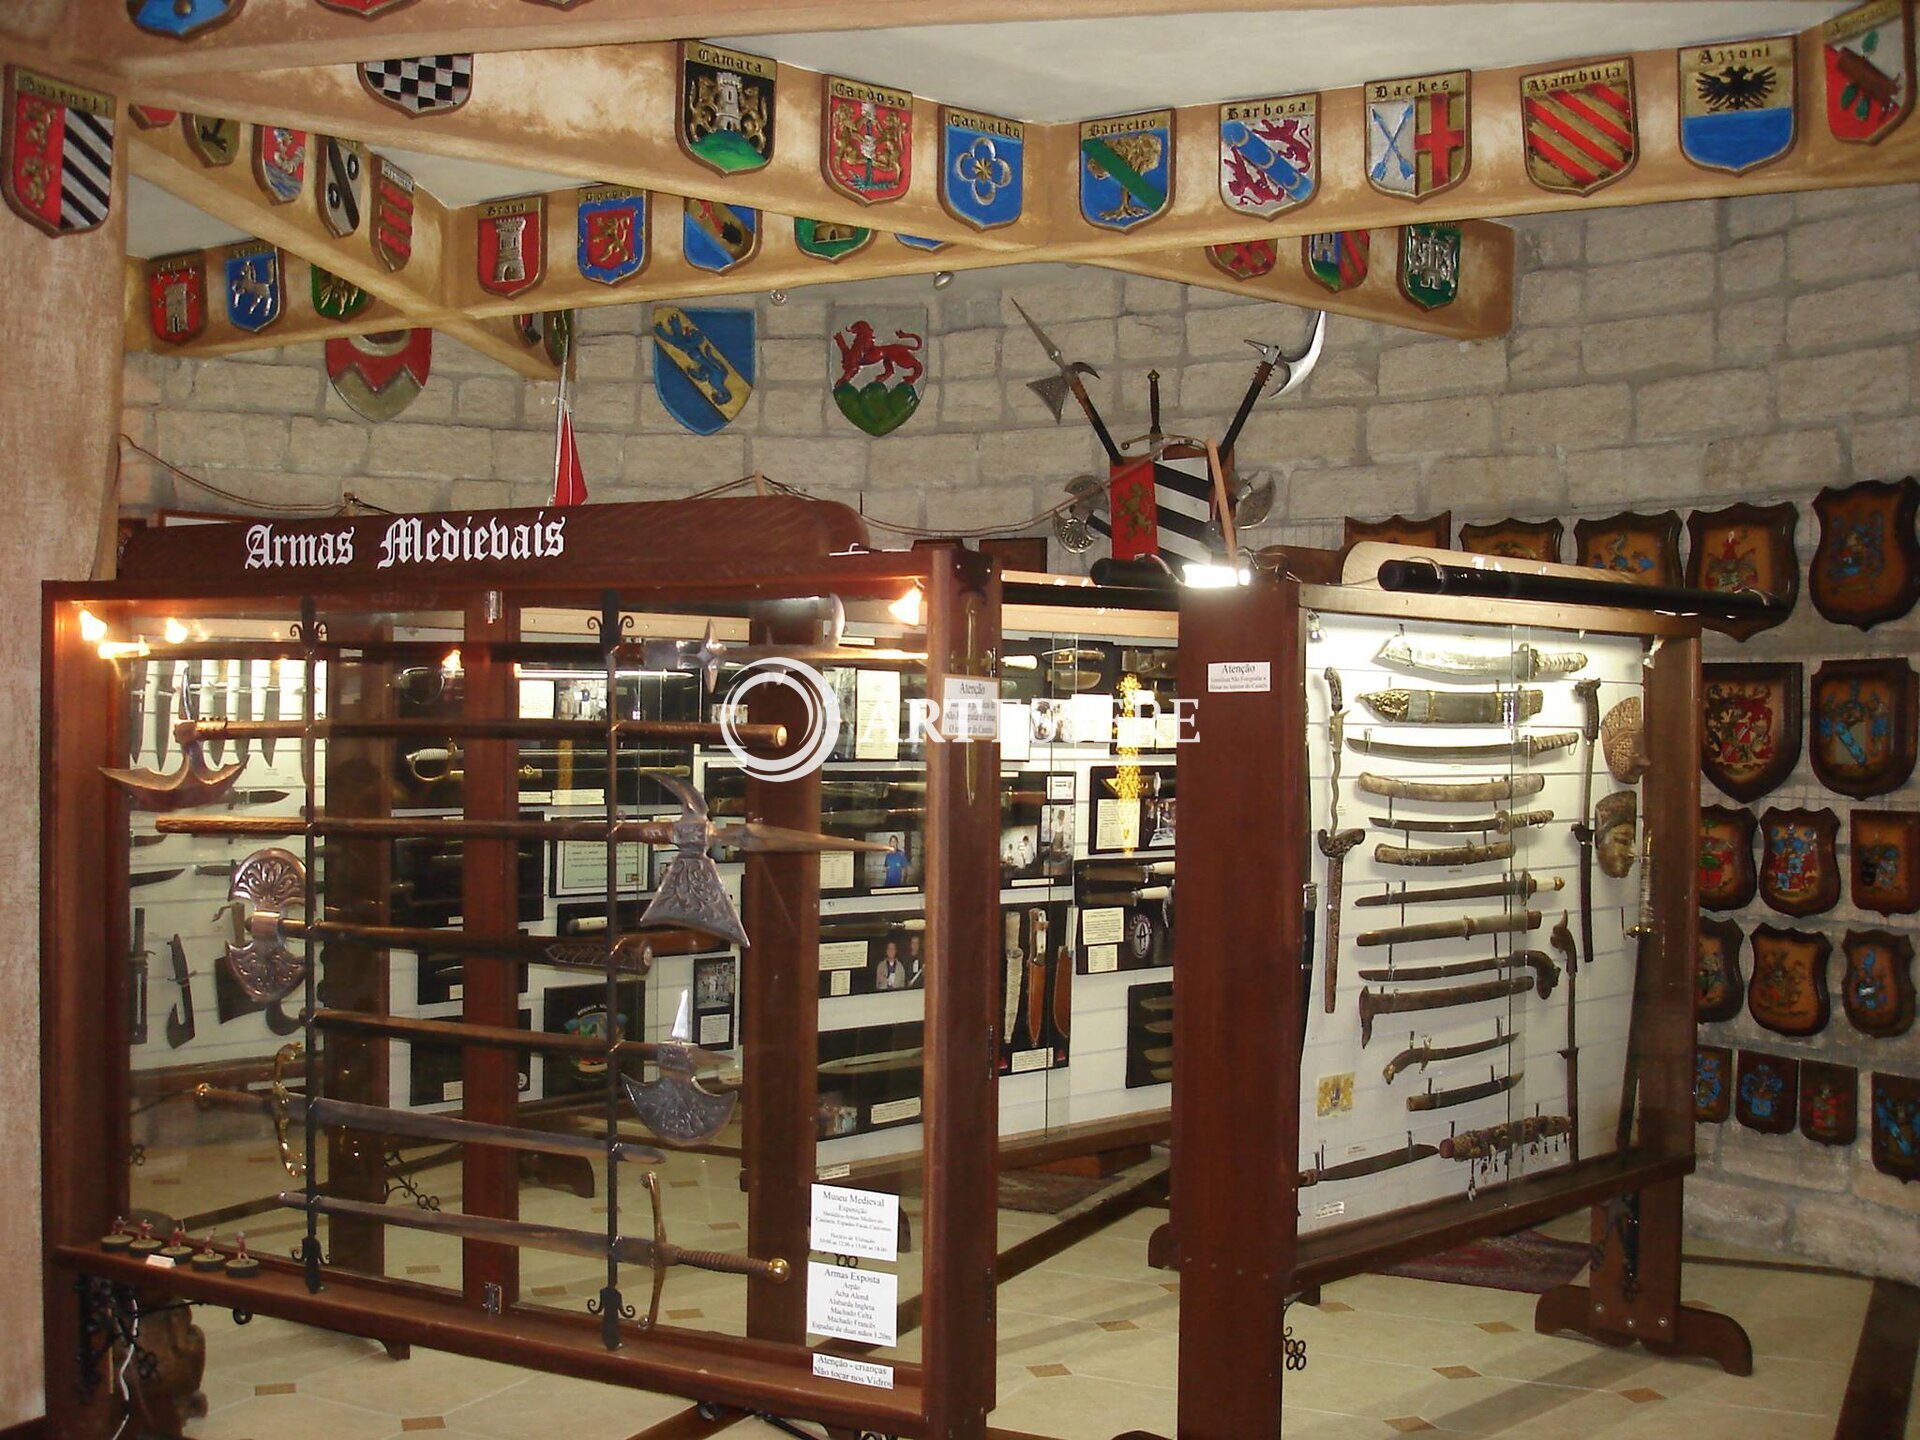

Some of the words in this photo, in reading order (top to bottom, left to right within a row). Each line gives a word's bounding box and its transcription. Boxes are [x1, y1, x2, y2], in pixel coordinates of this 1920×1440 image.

[1700, 44, 1770, 65] Azzoni
[834, 82, 906, 107] Cardoso
[1227, 102, 1307, 121] Barbosa
[1089, 118, 1156, 137] Barreiro
[244, 523, 355, 570] Armas
[376, 511, 567, 570] Medievais
[1222, 663, 1256, 675] Atenção
[960, 682, 986, 697] Atenção
[823, 1190, 848, 1202] Museu
[849, 1194, 885, 1207] Medieval
[825, 1268, 849, 1279] Armas
[817, 1355, 848, 1369] Atenção
[854, 1363, 887, 1375] crianças
[814, 1365, 829, 1376] Não
[830, 1370, 849, 1381] tocar
[850, 1375, 864, 1383] nos
[865, 1375, 893, 1388] Vidros
